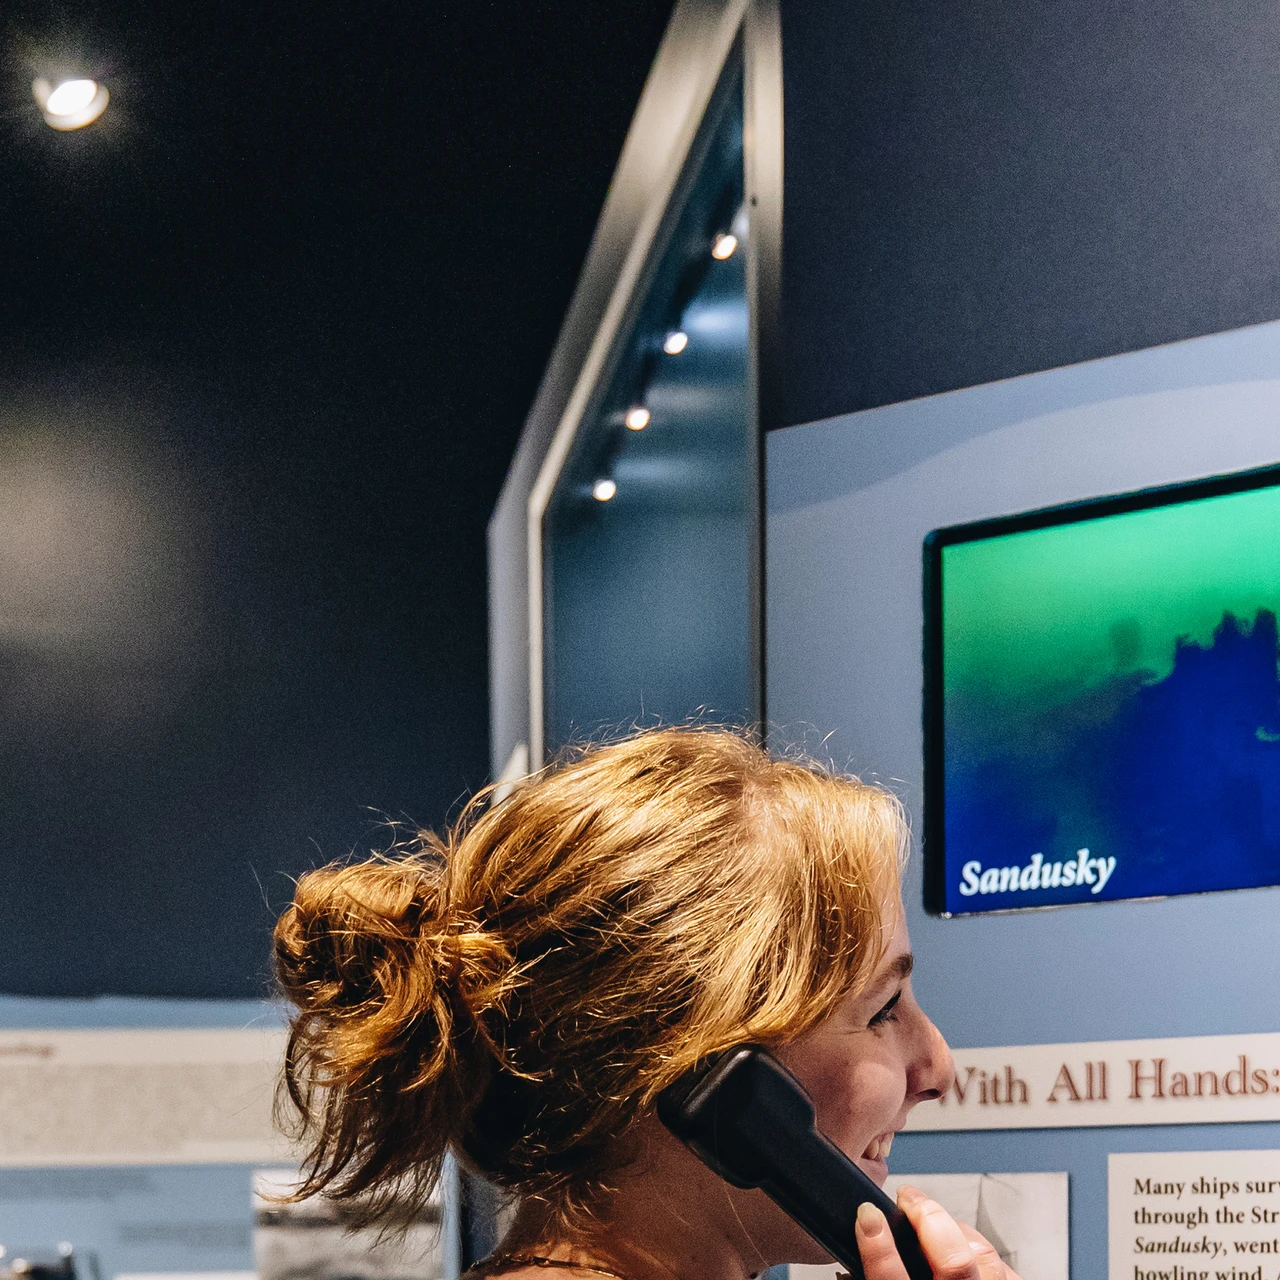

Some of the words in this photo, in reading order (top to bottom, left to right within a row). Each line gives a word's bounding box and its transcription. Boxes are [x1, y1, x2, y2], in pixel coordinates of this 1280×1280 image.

[958, 847, 1118, 897] Sandusky
[1046, 1060, 1110, 1102] All
[1133, 1177, 1186, 1201] Many
[1191, 1175, 1240, 1200] ships
[1133, 1205, 1209, 1230] through
[1215, 1205, 1246, 1225] the
